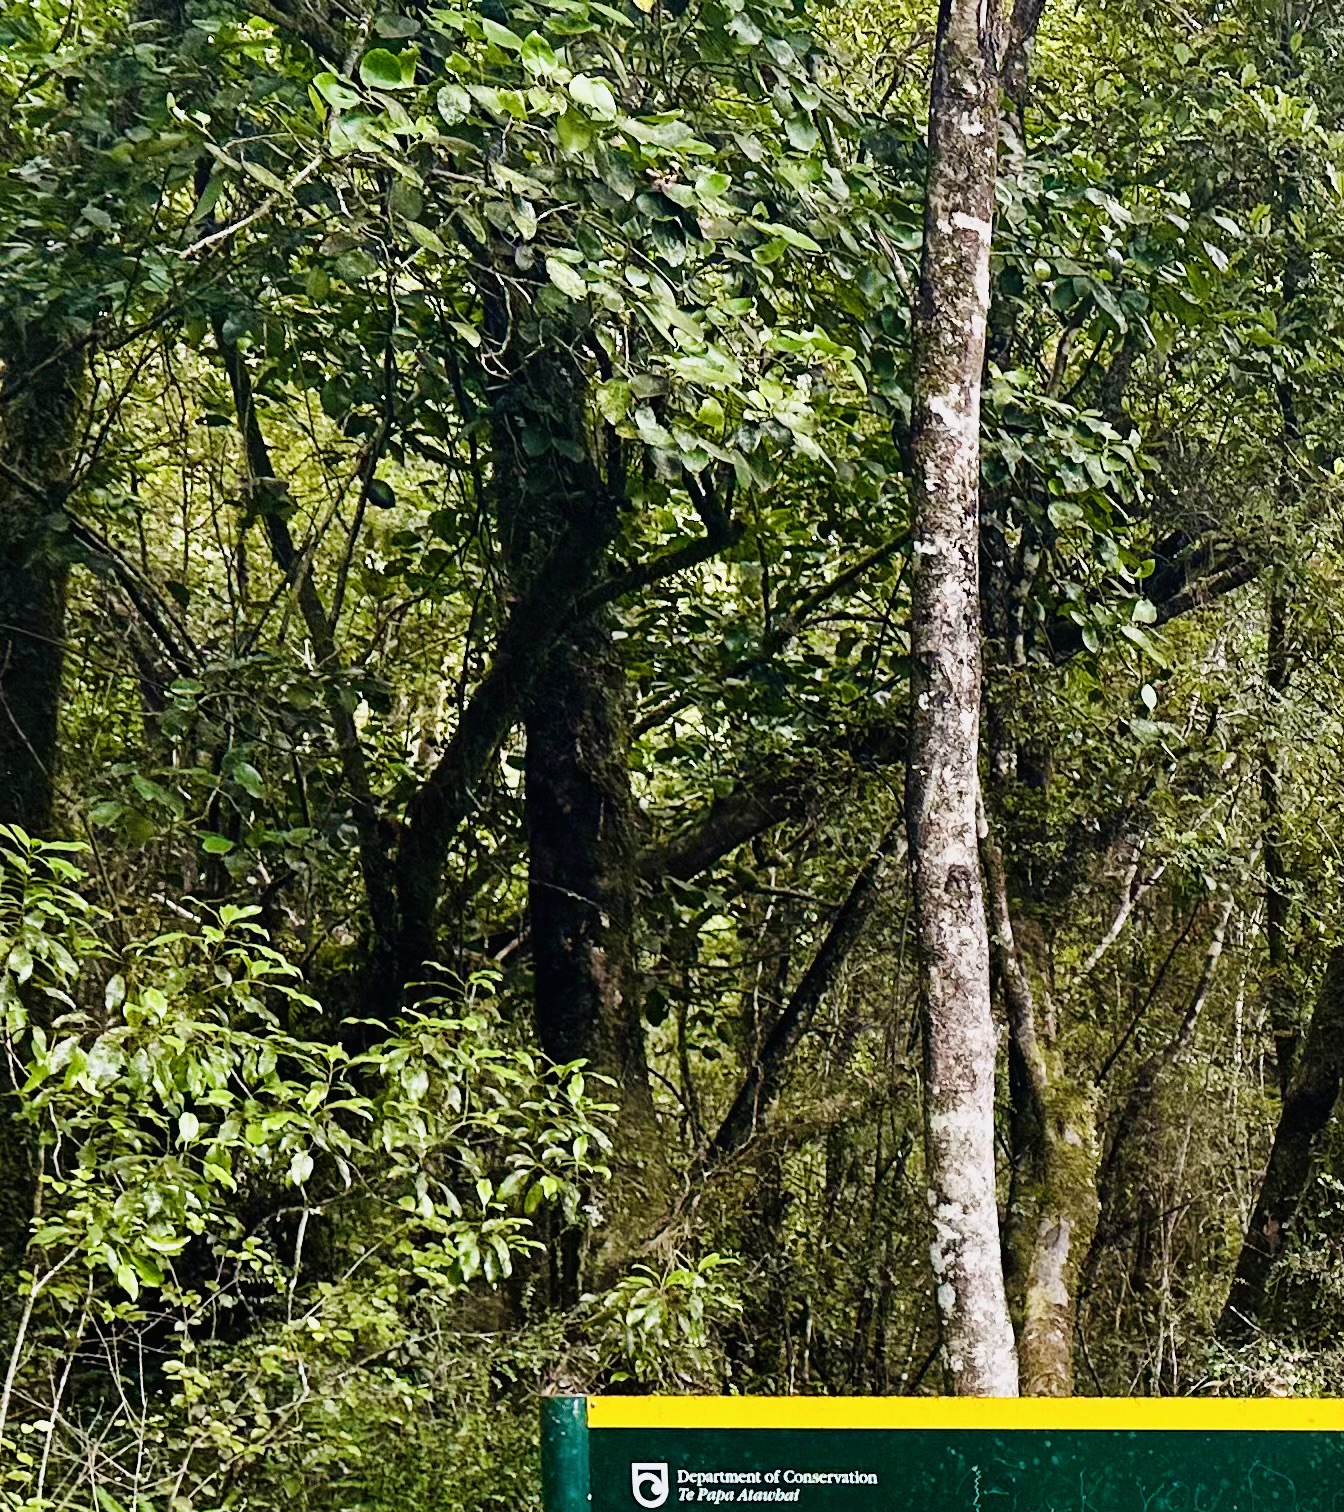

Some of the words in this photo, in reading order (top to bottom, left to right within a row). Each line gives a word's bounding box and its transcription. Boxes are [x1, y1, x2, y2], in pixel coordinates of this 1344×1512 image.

[677, 1469, 761, 1486] Department
[764, 1469, 780, 1484] of
[783, 1470, 878, 1485] Conservation
[678, 1487, 695, 1501] Te
[697, 1488, 735, 1504] Papa
